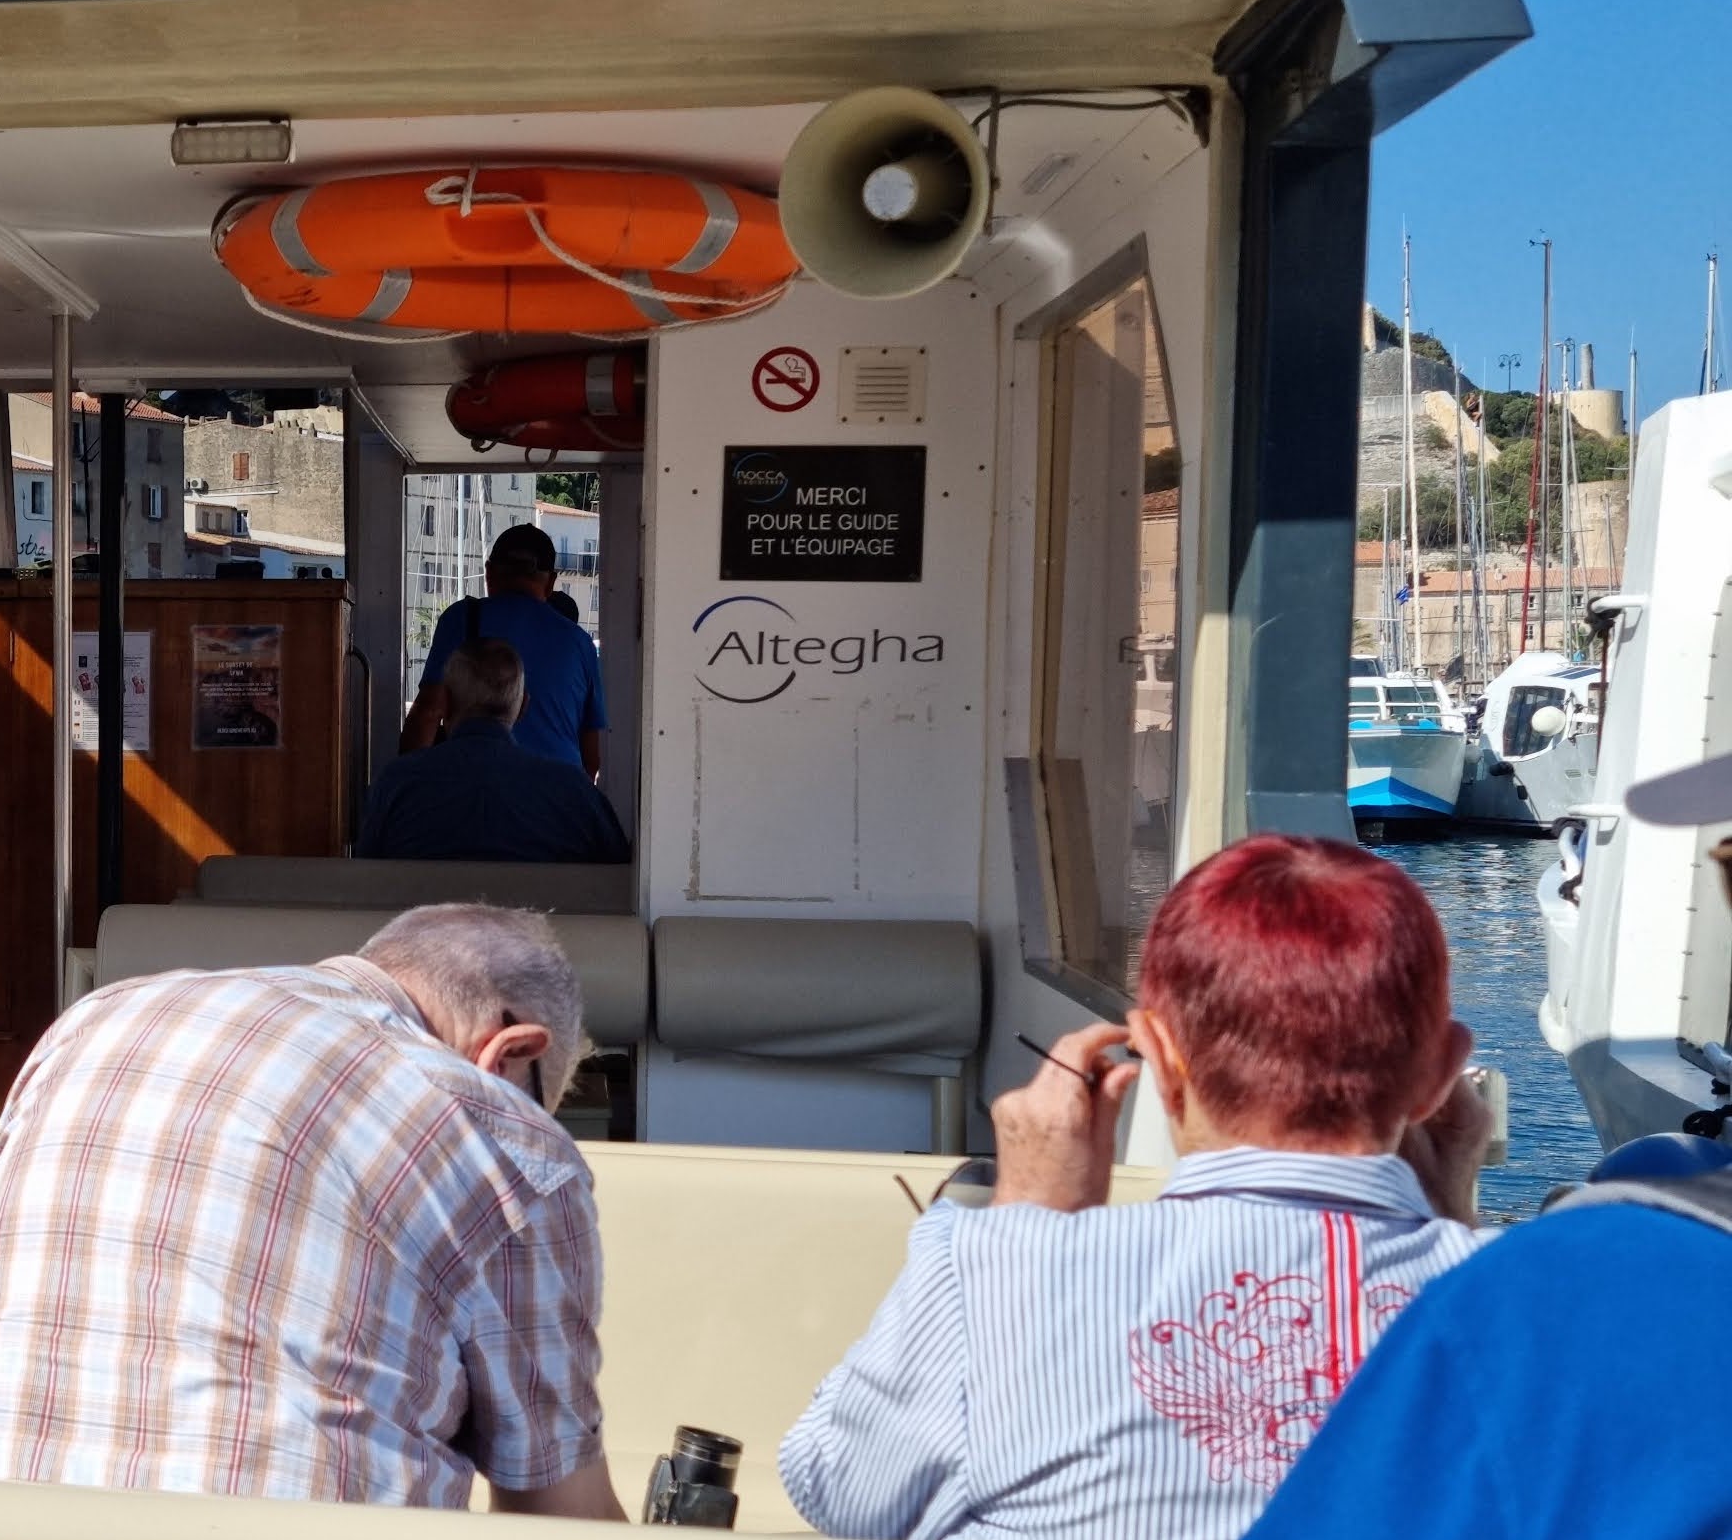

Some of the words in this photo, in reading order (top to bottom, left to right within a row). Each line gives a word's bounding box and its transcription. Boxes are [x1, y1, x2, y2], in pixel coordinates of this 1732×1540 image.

[795, 487, 867, 506] MERCI
[747, 514, 803, 531] POUR
[808, 514, 832, 530] LE
[838, 514, 900, 531] GUIDE
[751, 538, 776, 555] ET
[781, 535, 895, 556] L'ÉQUIPAGE
[707, 629, 945, 675] Altegha
